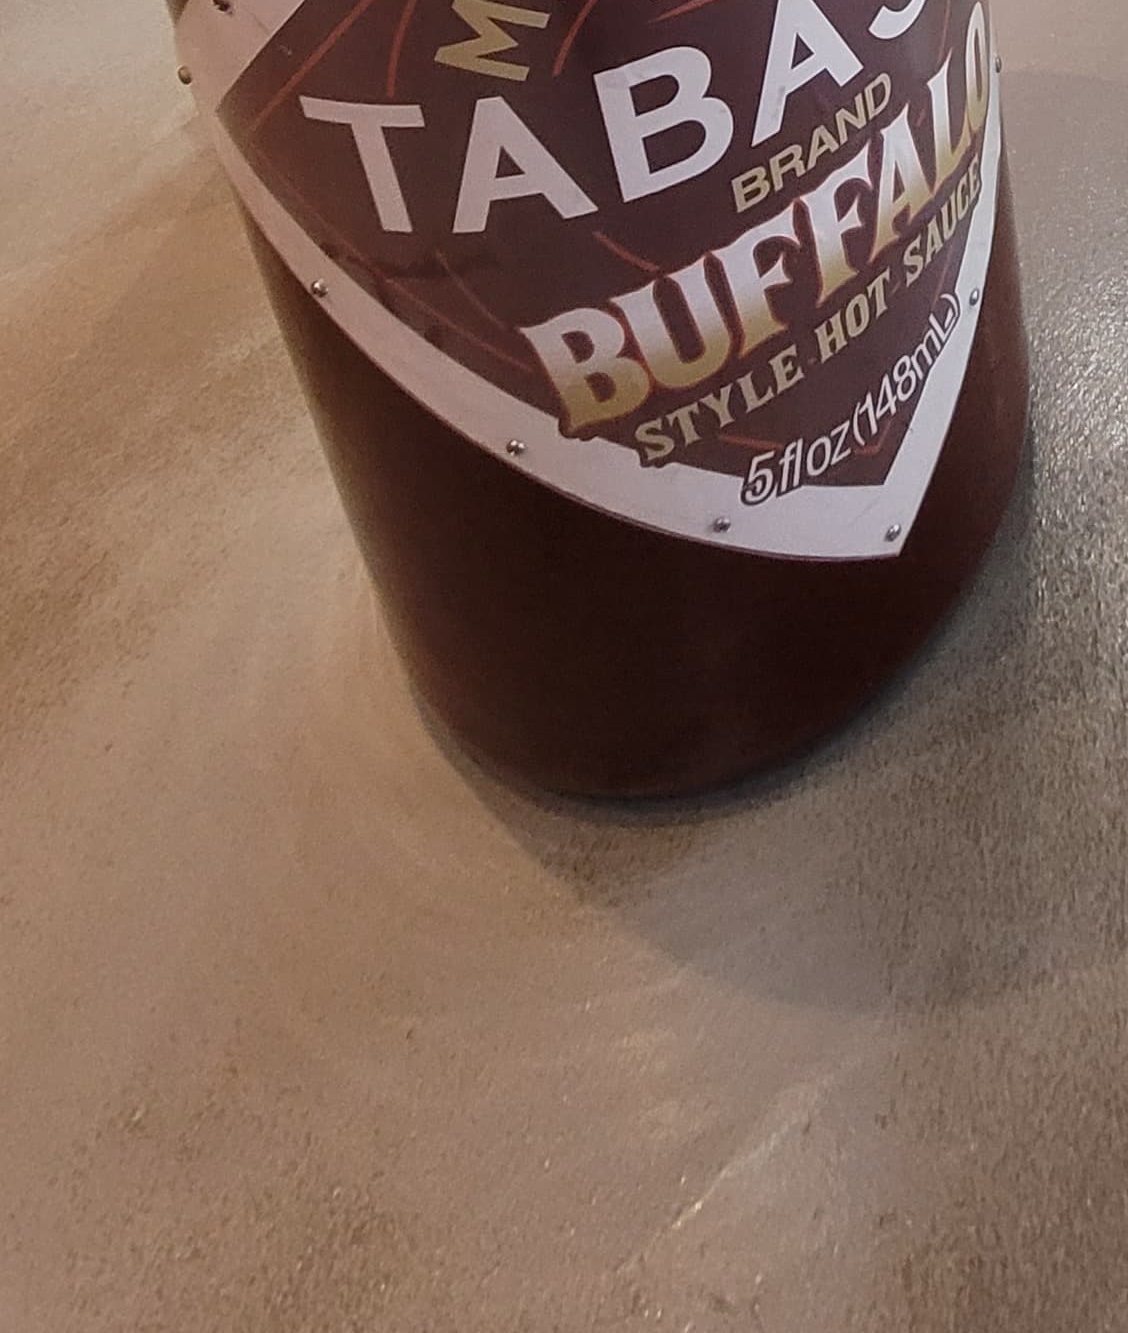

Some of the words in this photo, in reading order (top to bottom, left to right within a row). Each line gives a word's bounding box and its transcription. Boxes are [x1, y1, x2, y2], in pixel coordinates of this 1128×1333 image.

[520, 0, 990, 430] BUFFALO
[731, 73, 891, 212] BRAND
[633, 344, 804, 461] STYLE
[813, 266, 890, 364] HOT
[902, 155, 982, 286] SAUCE
